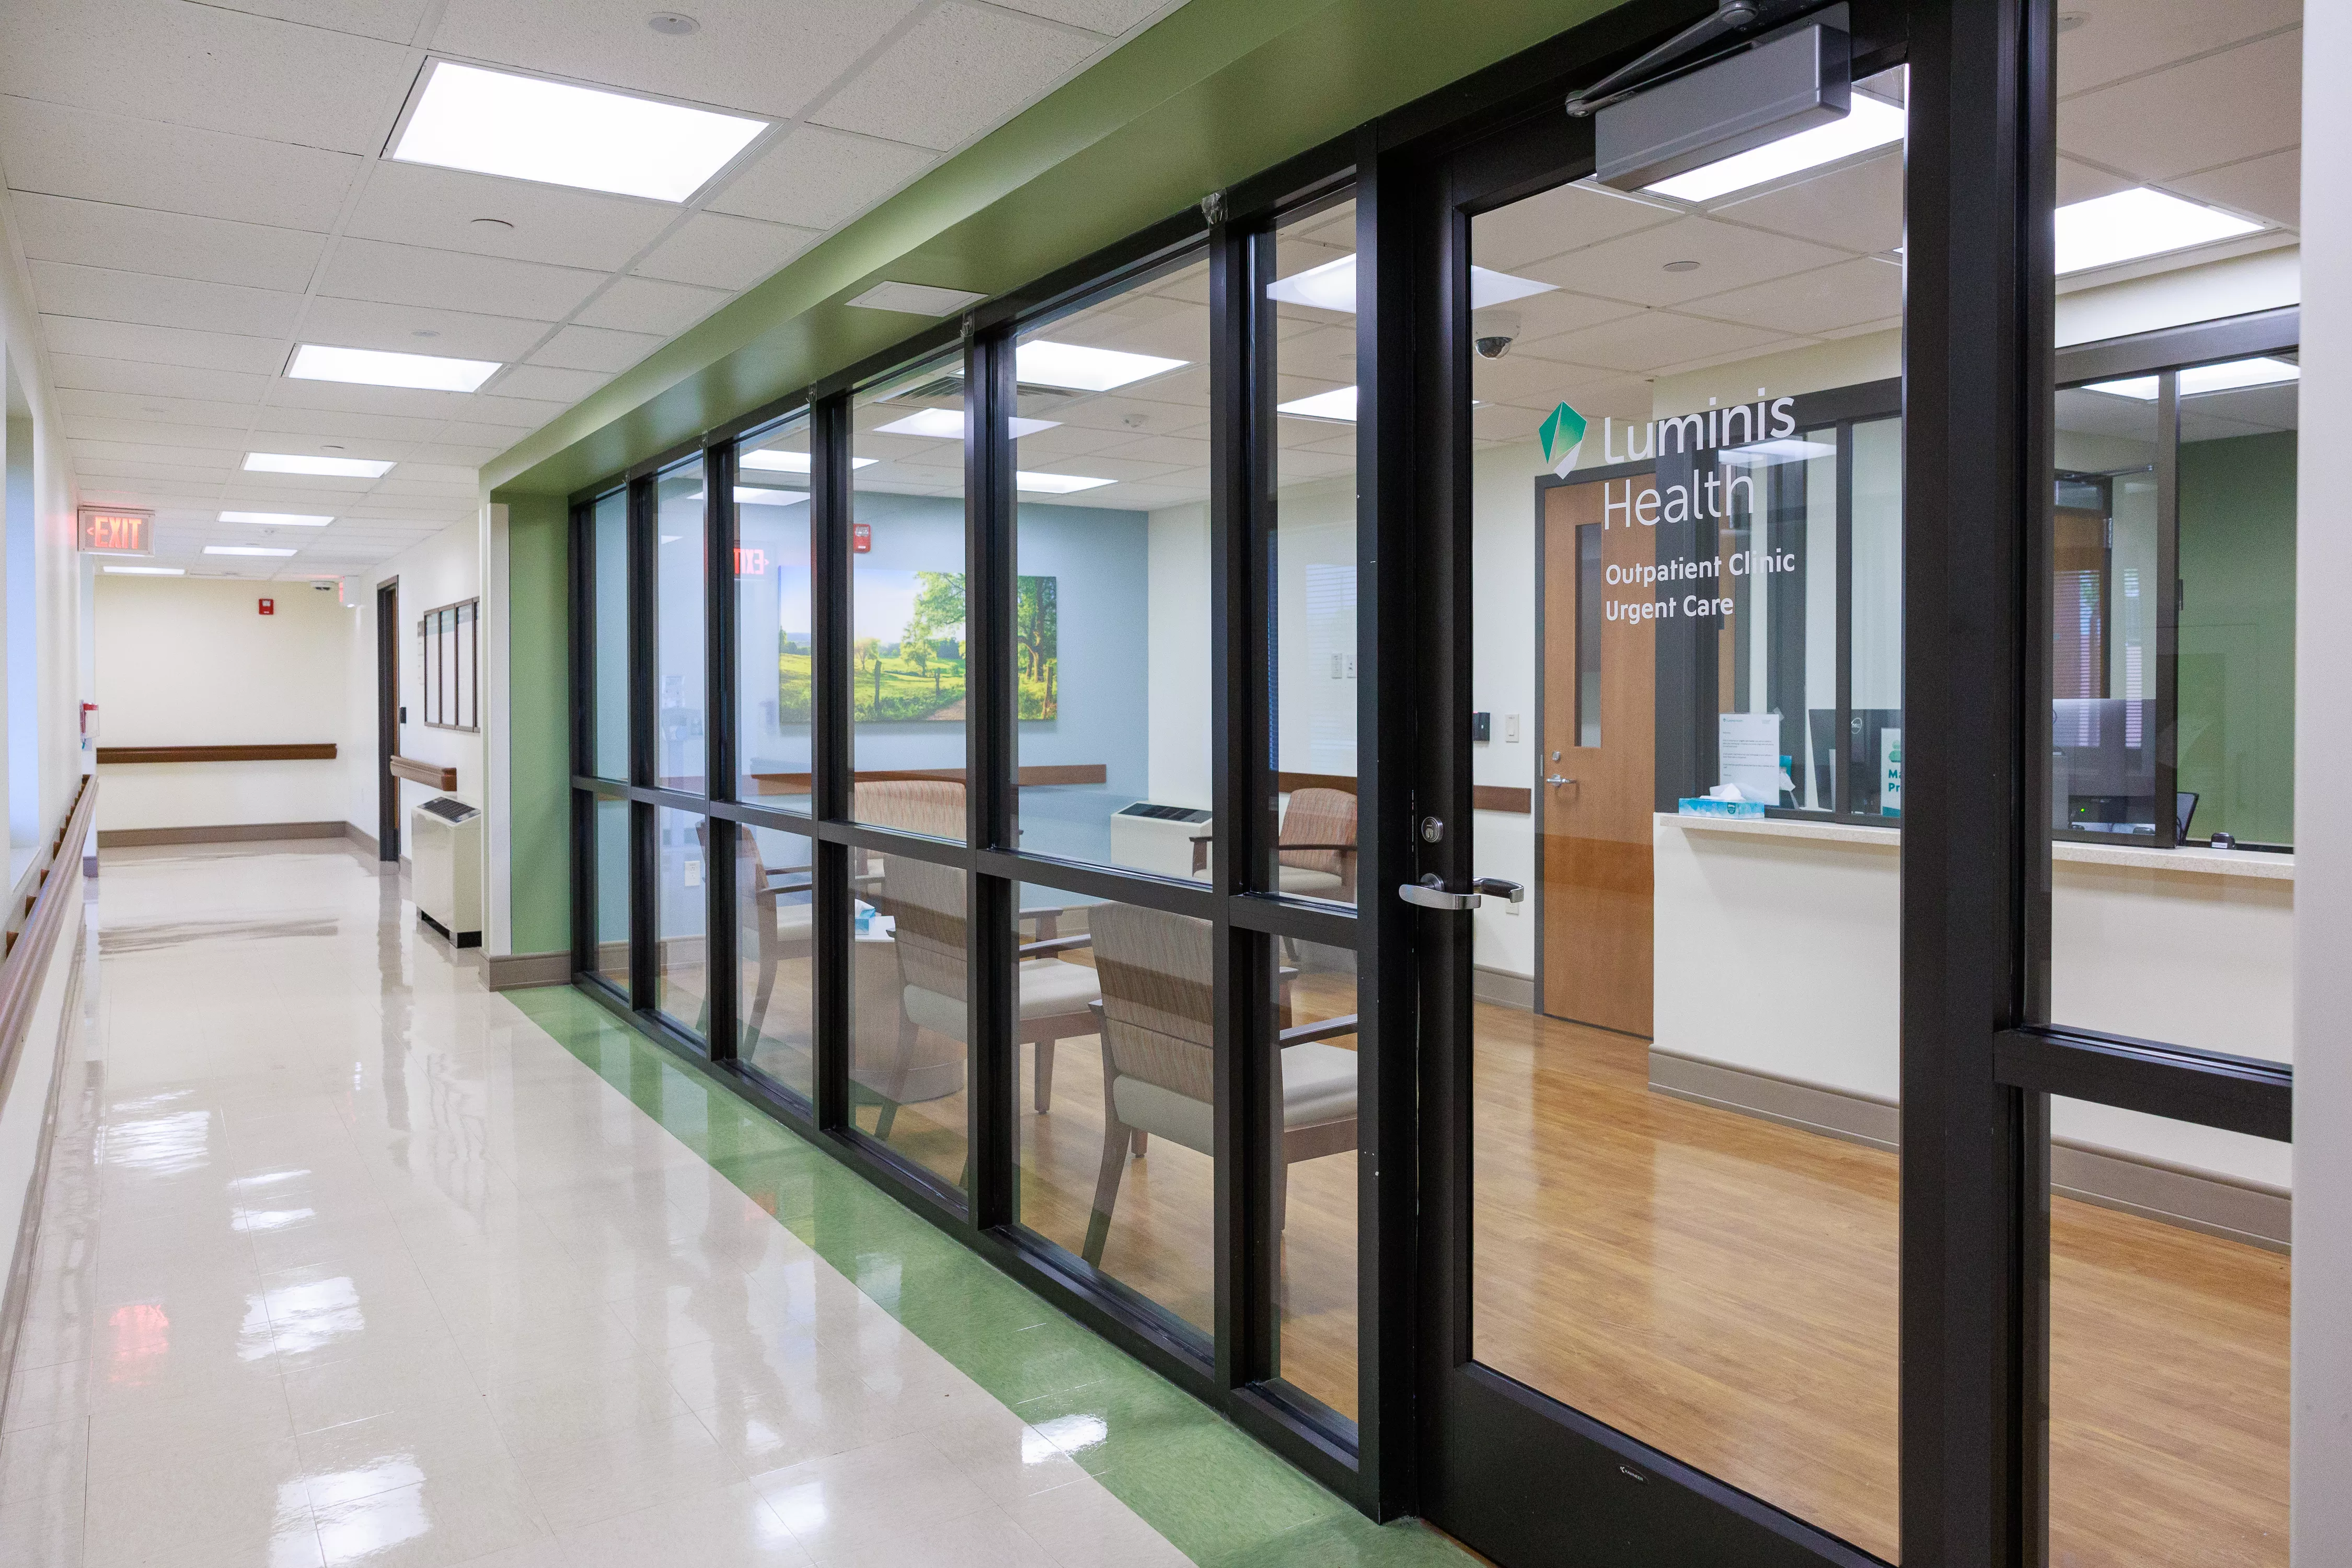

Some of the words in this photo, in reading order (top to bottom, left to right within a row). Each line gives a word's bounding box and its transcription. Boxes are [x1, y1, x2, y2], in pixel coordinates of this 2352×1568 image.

[1604, 387, 1795, 464] Luminis
[1604, 465, 1754, 530] Health
[95, 516, 142, 549] EXIT
[1606, 556, 1722, 587] Outpatient
[1728, 548, 1795, 575] Clinic
[1606, 597, 1677, 625] Urgent
[1683, 595, 1734, 617] Care
[1888, 769, 1901, 778] M
